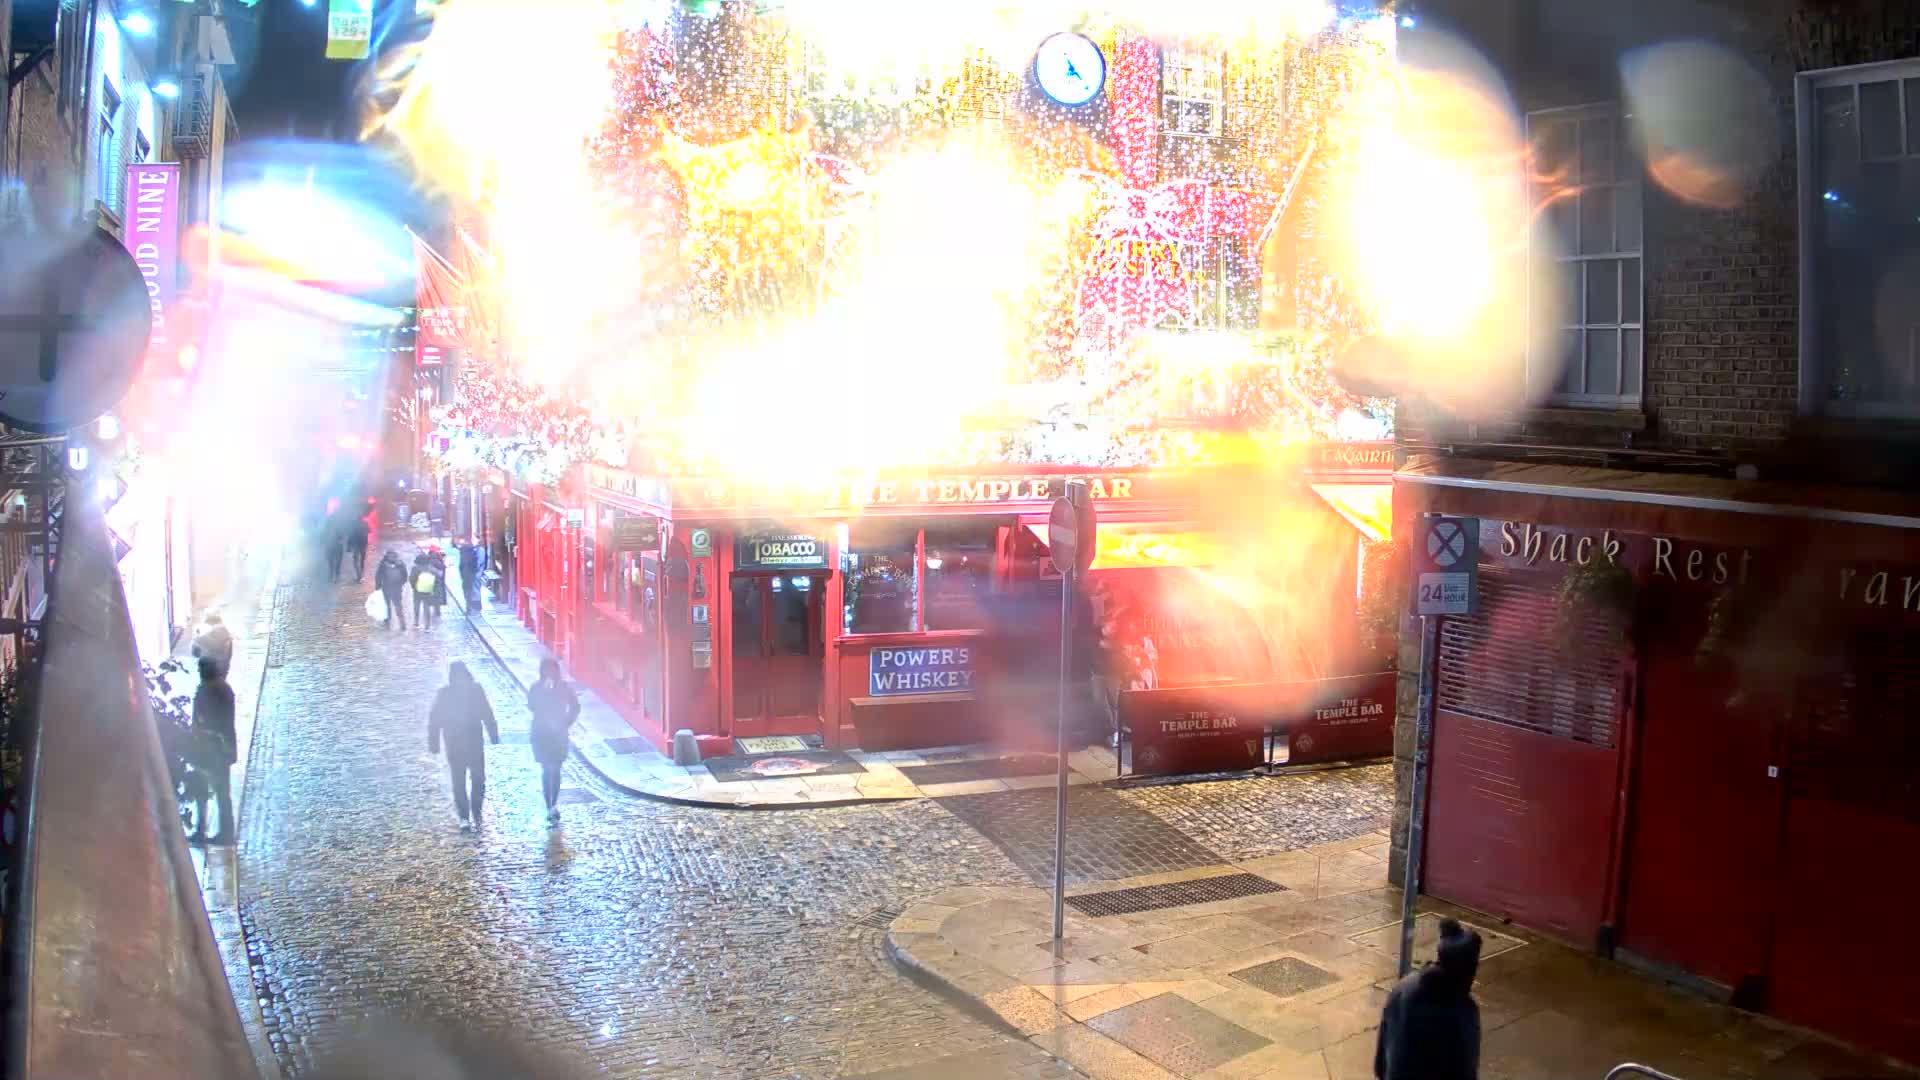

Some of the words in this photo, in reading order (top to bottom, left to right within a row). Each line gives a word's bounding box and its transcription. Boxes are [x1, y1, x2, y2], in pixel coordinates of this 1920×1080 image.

[137, 171, 169, 232] NINE
[917, 478, 1049, 501] TEMPLE
[750, 538, 816, 562] TOBACCO
[1500, 520, 1620, 566] Shack
[1421, 583, 1442, 602] 24
[879, 647, 969, 668] POWER'S
[873, 671, 973, 690] WHISKEY
[1315, 706, 1358, 721] TEMPLE
[1360, 703, 1384, 716] BAR
[1159, 719, 1209, 732] TEMPLE
[1213, 716, 1240, 729] BAR
